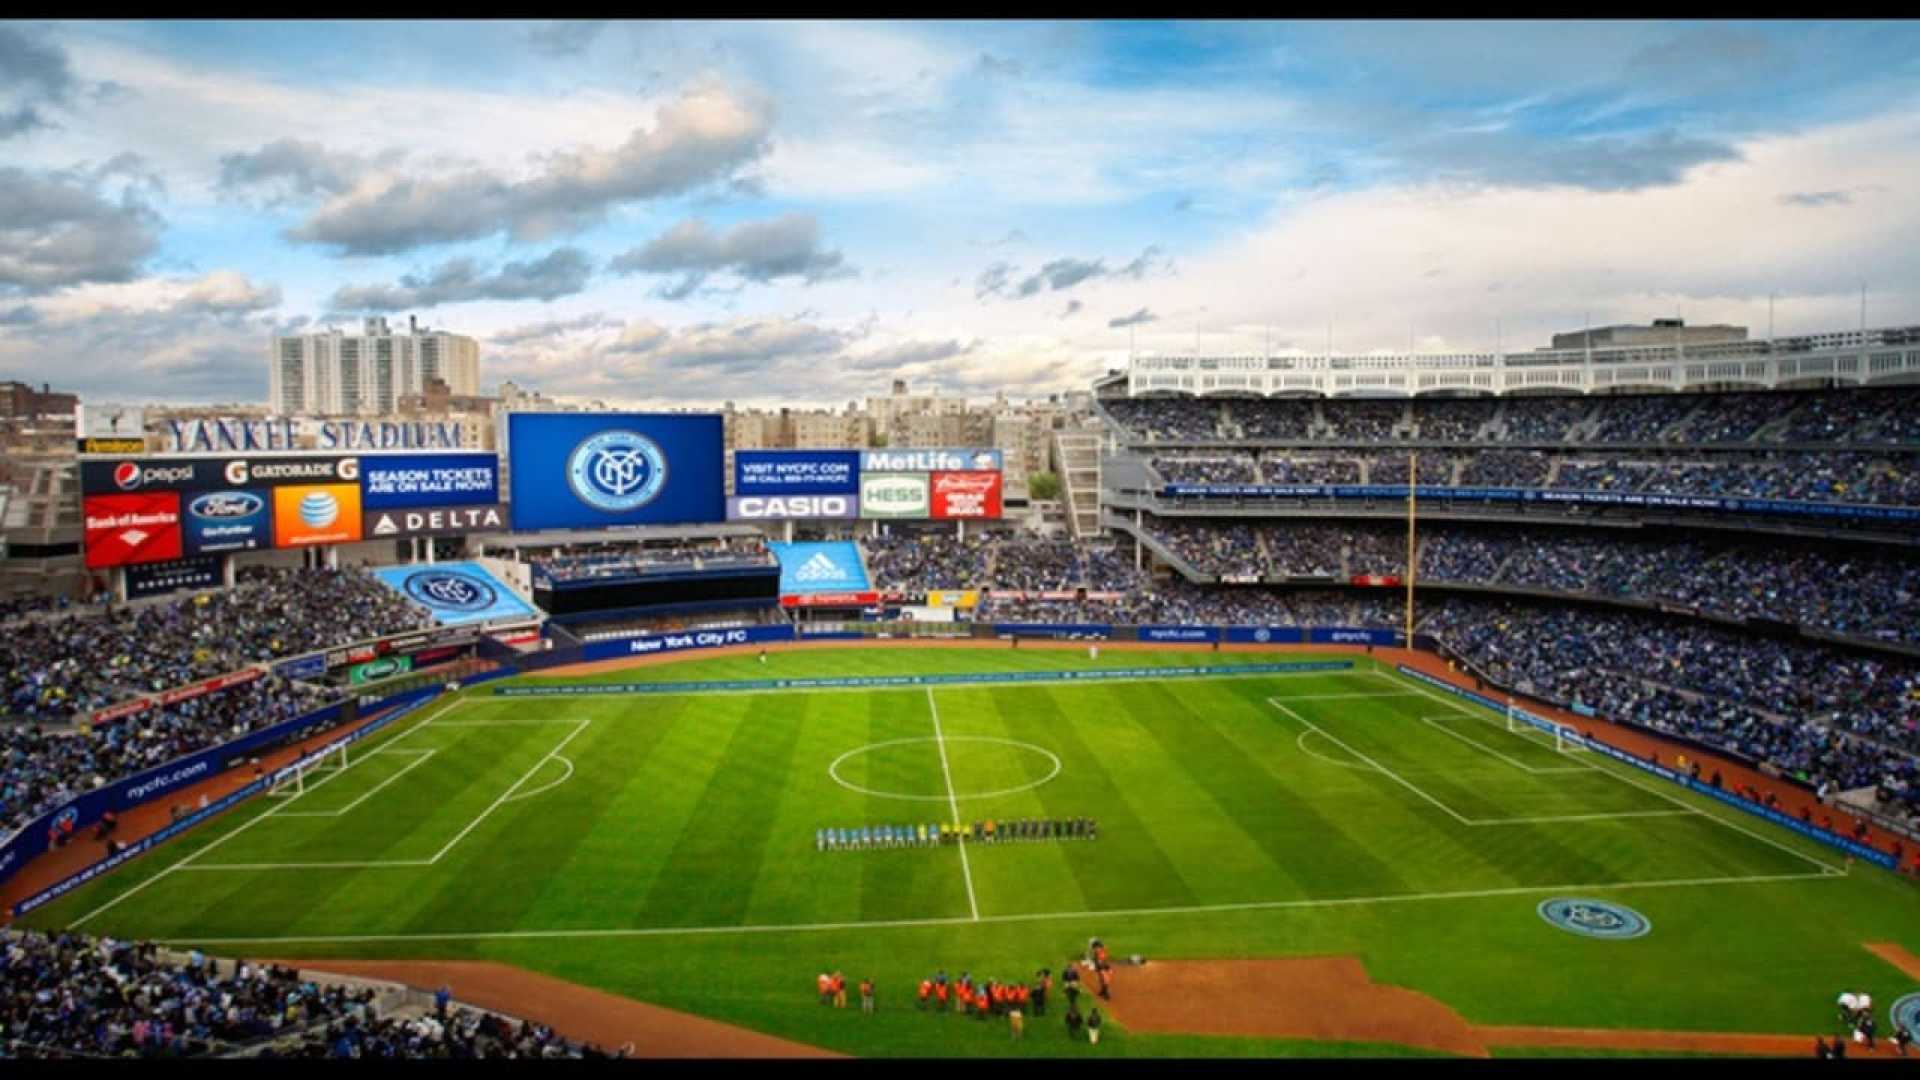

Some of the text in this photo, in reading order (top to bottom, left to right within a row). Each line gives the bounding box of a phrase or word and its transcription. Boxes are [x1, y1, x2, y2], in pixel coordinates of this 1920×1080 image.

[167, 418, 301, 450] YANKEE
[319, 419, 462, 449] STADIUM
[743, 463, 774, 473] VISIT
[866, 450, 963, 470] MetLife
[143, 464, 194, 484] pepsi
[252, 463, 333, 479] GATORADE
[368, 467, 493, 481] SEASON TICKETS
[758, 474, 783, 483] CALL
[368, 479, 493, 492] ARE ON SALE NOW!
[867, 487, 923, 502] HESS
[204, 494, 250, 516] Ford
[739, 496, 846, 517] CASIO
[86, 511, 177, 529] Bank of America
[406, 509, 501, 531] DELTA
[629, 629, 747, 652] New York City FC
[127, 761, 208, 799] nycfc.com
